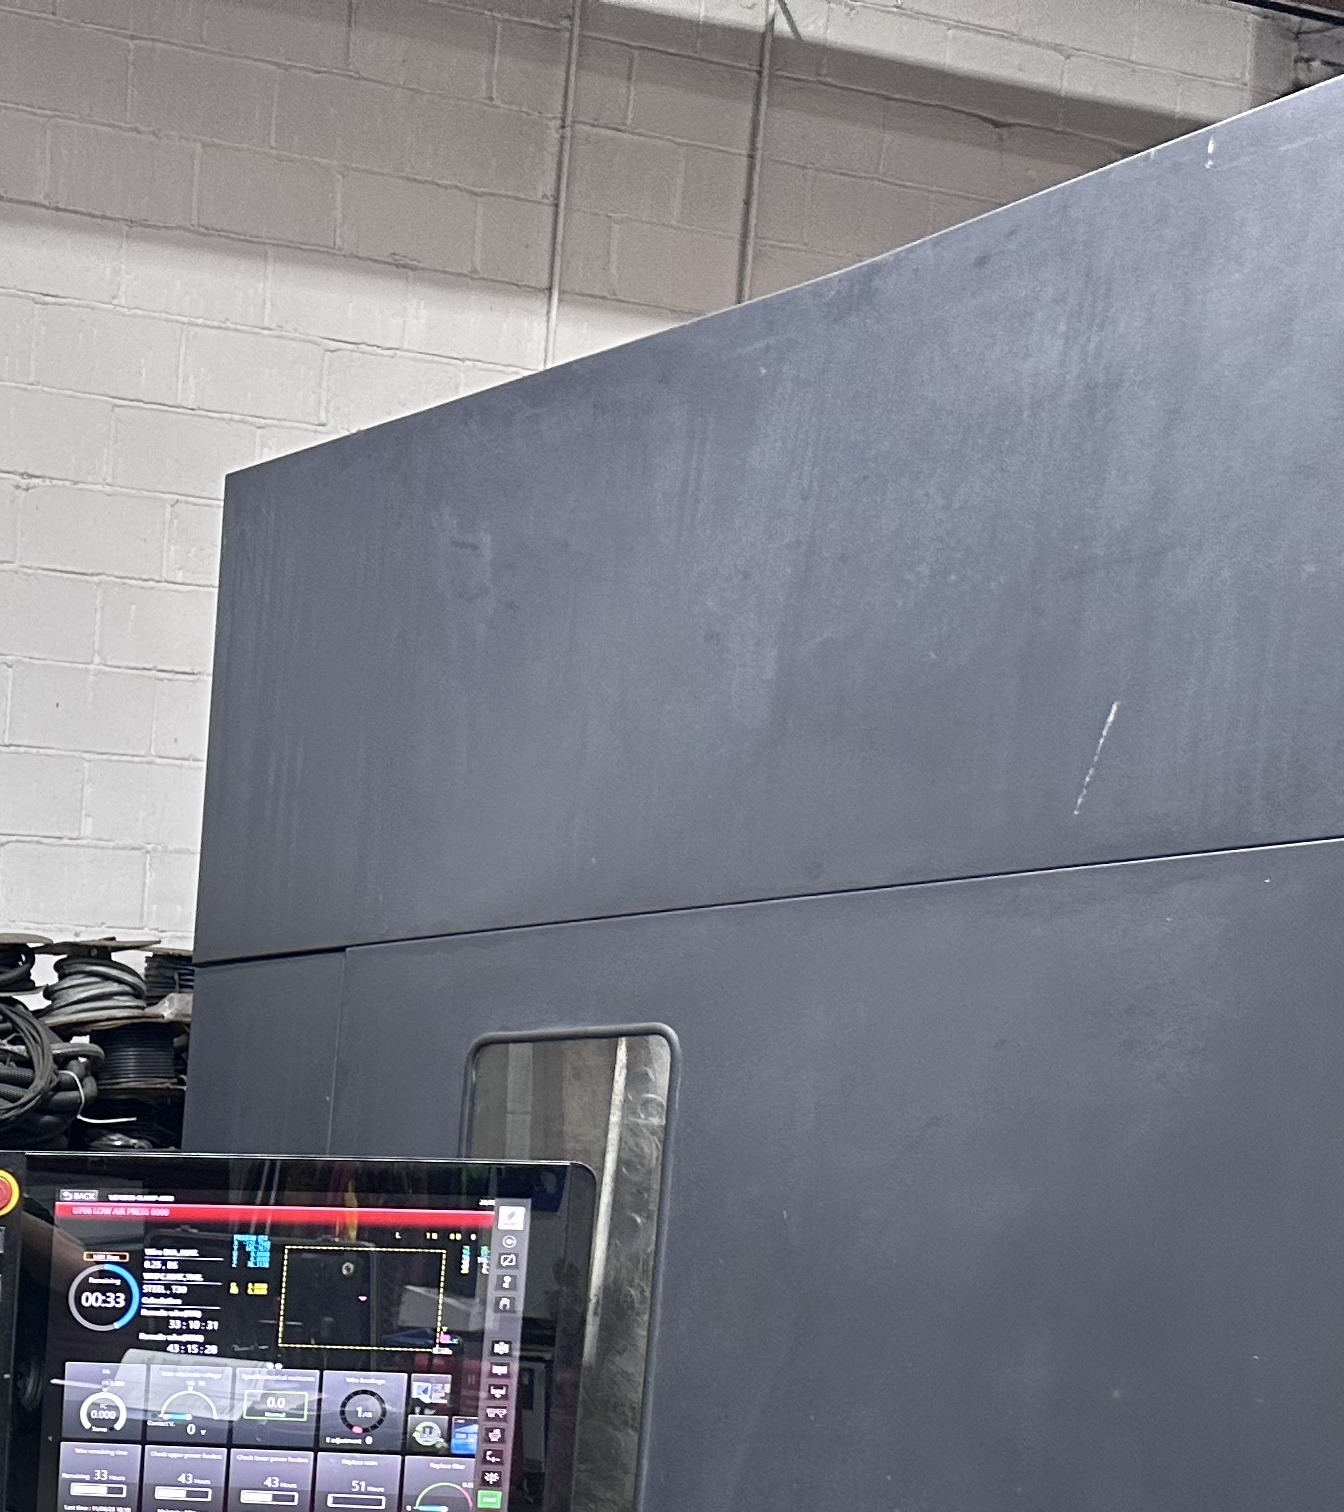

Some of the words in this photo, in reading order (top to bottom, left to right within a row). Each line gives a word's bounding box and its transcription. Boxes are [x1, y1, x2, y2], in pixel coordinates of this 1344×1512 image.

[81, 1292, 126, 1308] 00:33
[93, 1469, 108, 1481] 33
[177, 1473, 193, 1484] 43
[263, 1477, 279, 1488] 43
[351, 1480, 366, 1491] 51
